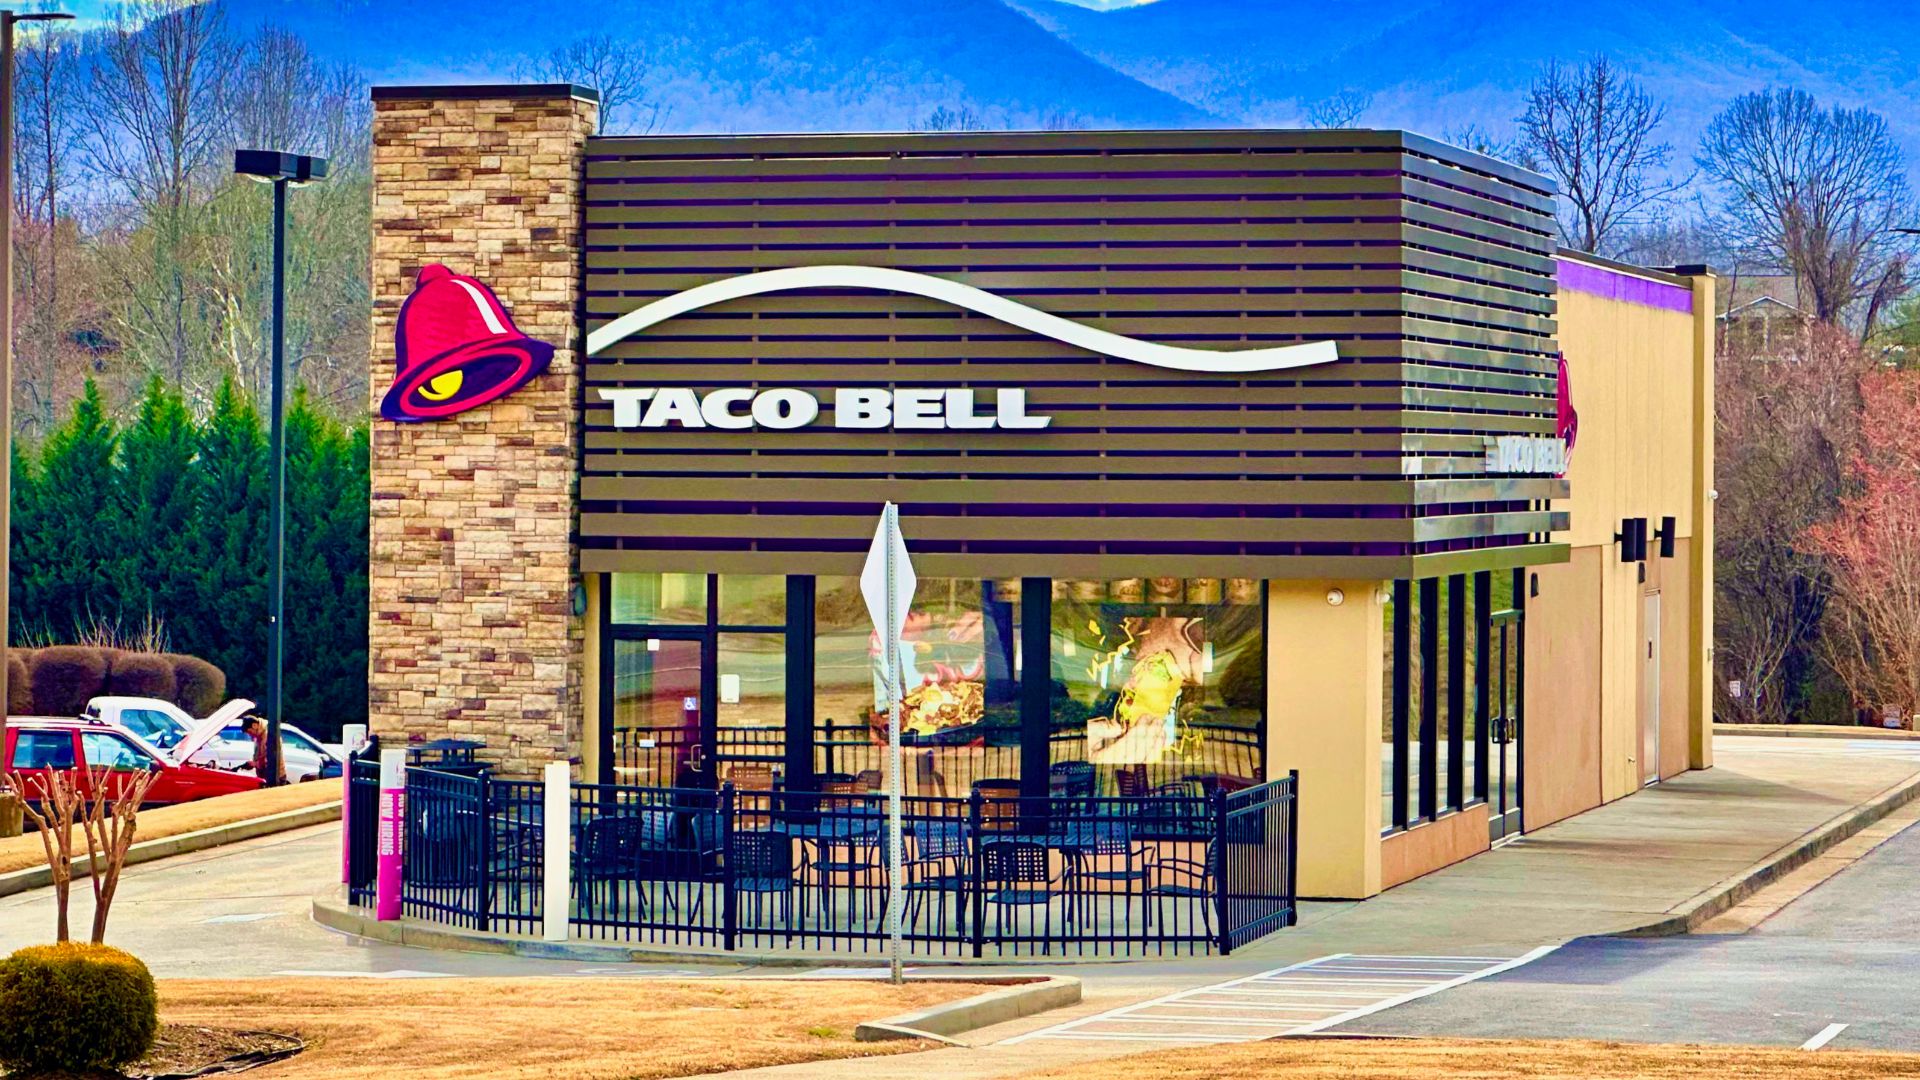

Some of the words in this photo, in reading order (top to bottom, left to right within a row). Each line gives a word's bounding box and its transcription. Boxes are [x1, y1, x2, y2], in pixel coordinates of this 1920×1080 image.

[597, 387, 819, 429] TACO
[835, 387, 1052, 429] BELL
[381, 793, 394, 819] NOW
[381, 820, 394, 856] HIRING
